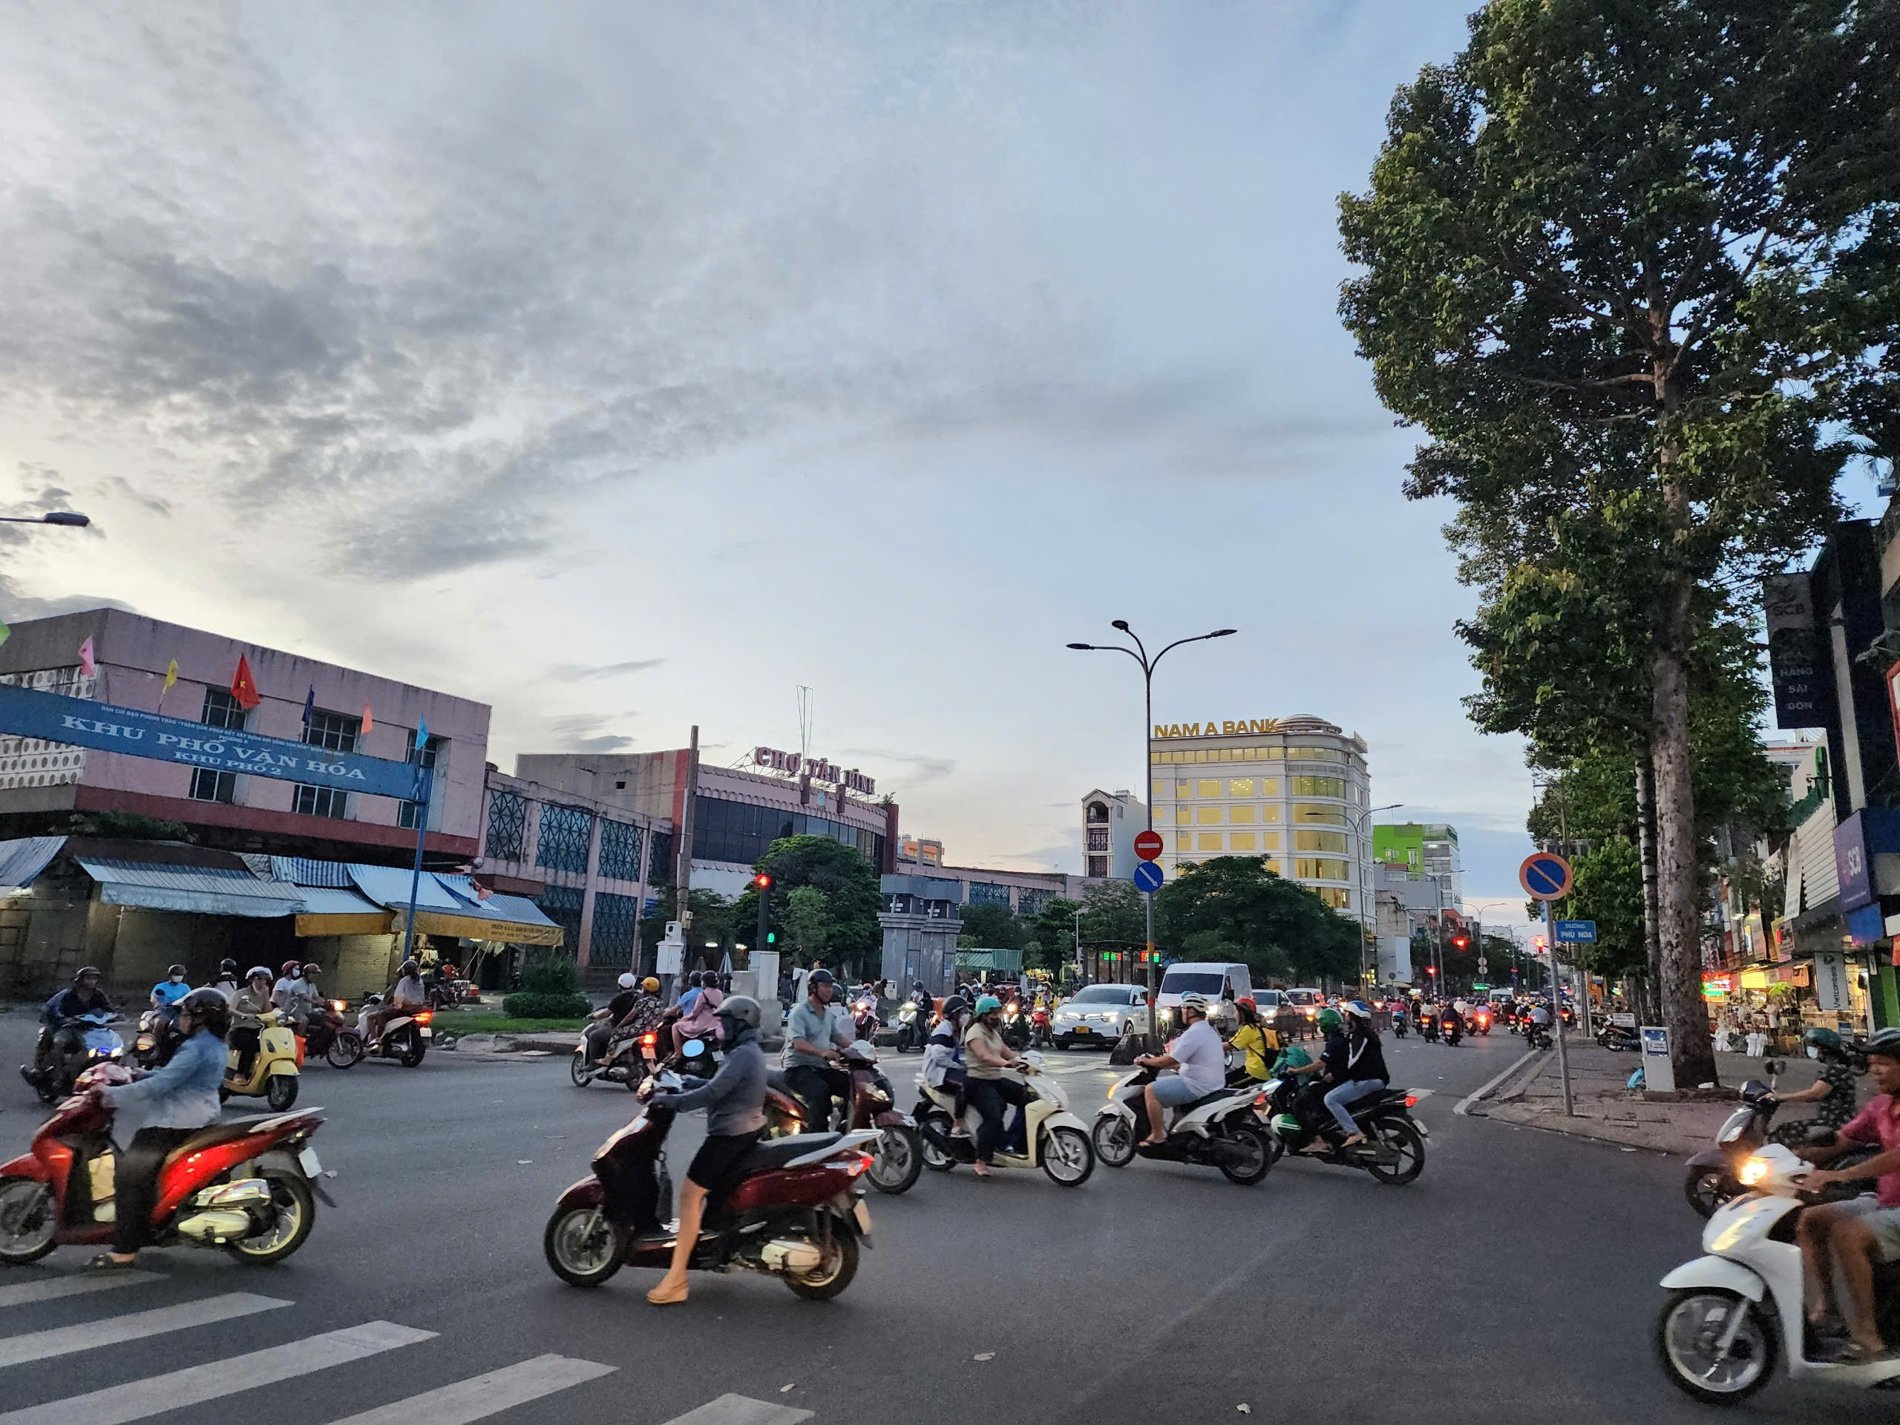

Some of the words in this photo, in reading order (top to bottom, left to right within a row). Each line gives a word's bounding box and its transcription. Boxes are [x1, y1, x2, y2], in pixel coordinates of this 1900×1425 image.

[1772, 603, 1806, 616] SCB
[1154, 722, 1200, 738] NAM
[1204, 721, 1219, 736] A
[1222, 718, 1279, 735] BANK
[62, 715, 146, 740] KHU
[156, 732, 226, 754] PHỐ
[233, 746, 299, 768] VĂN
[306, 761, 366, 781] HÓA
[174, 751, 222, 766] KHU
[226, 759, 268, 773] PHỐ
[271, 767, 282, 776] 2
[755, 746, 802, 776] CHỢ
[805, 757, 842, 784] TÂN
[844, 768, 876, 795] BÌNH
[1848, 846, 1862, 878] SCB
[1830, 965, 1841, 1009] Vietcombank
